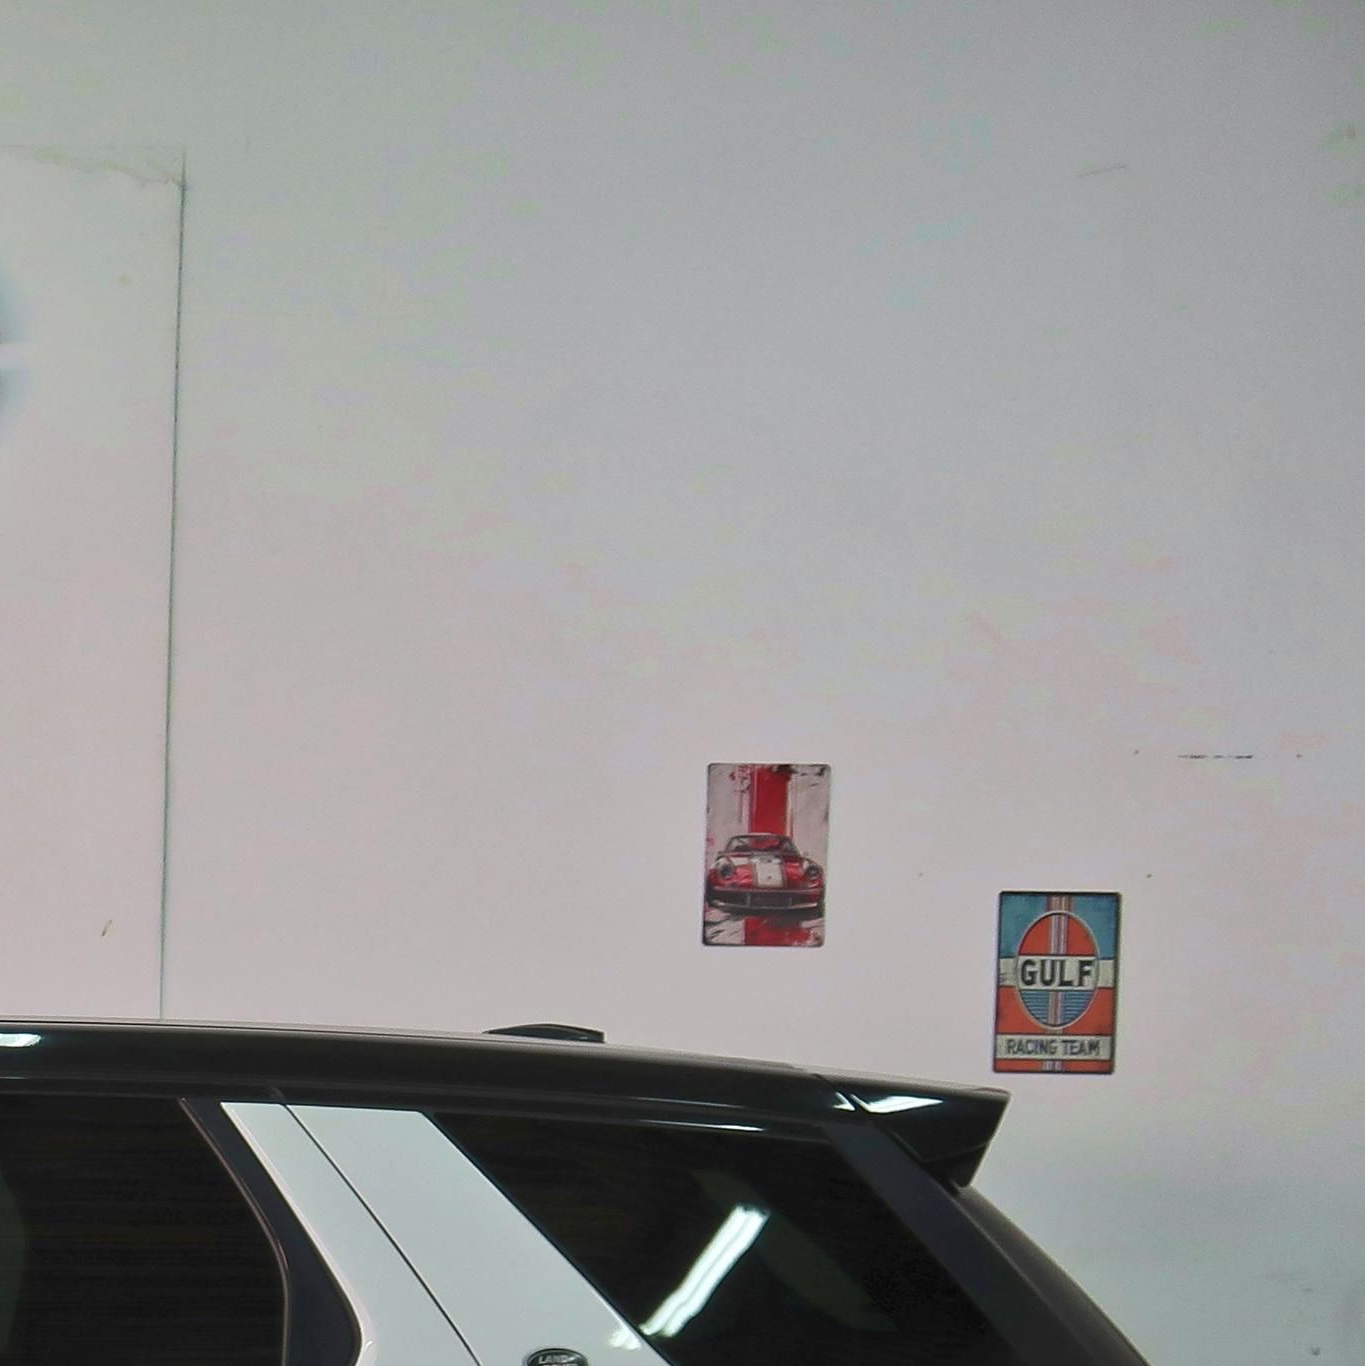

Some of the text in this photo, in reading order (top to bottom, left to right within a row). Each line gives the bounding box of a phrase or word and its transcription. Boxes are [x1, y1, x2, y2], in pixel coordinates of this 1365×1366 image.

[1020, 959, 1094, 987] GULF
[1005, 1037, 1101, 1057] RACING TEAM
